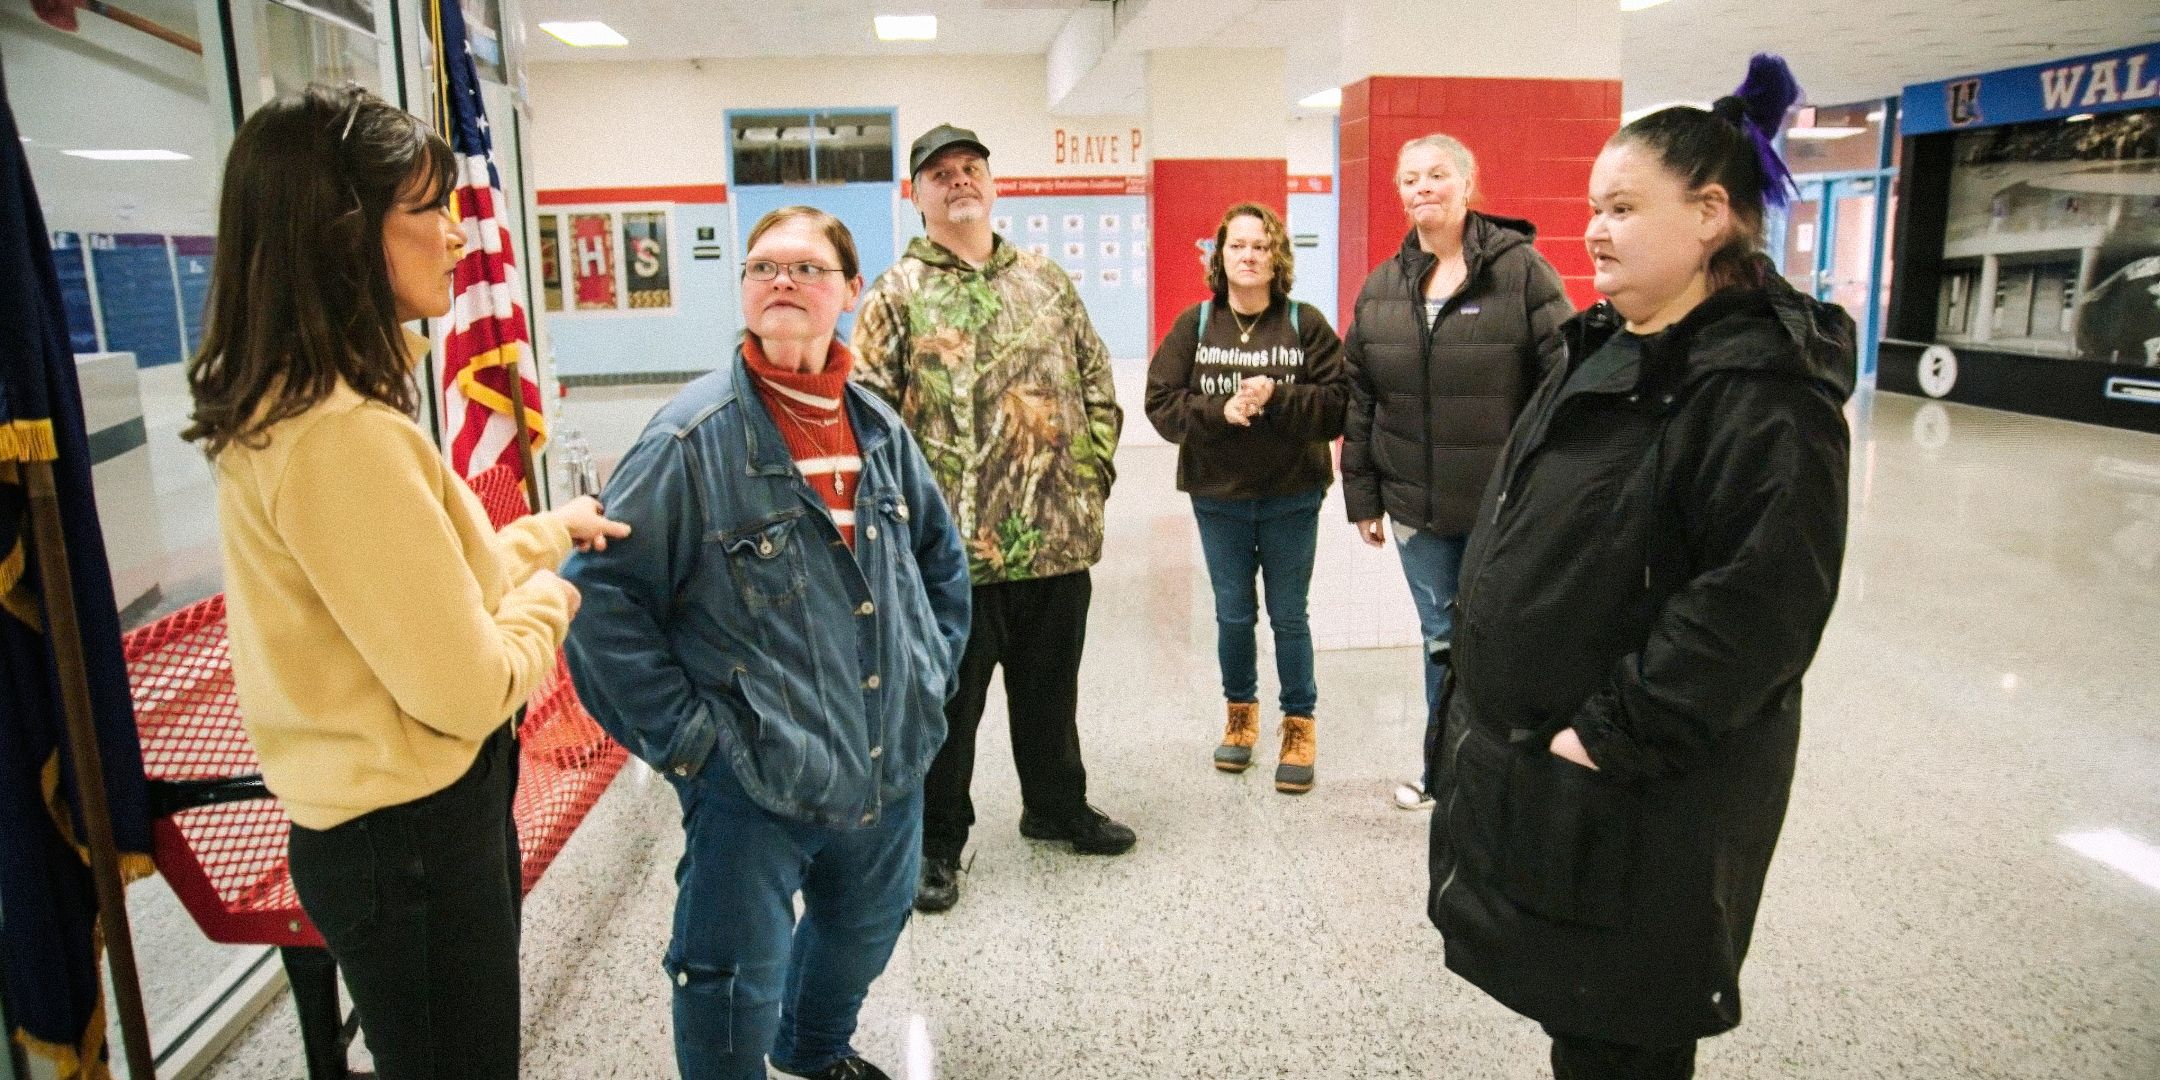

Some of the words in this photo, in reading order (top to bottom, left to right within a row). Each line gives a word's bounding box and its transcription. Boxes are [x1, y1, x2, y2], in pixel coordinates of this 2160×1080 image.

[1056, 129, 1118, 164] BRAVE
[577, 236, 607, 277] H
[634, 238, 661, 278] S
[1271, 346, 1278, 366] I
[1201, 373, 1216, 395] to
